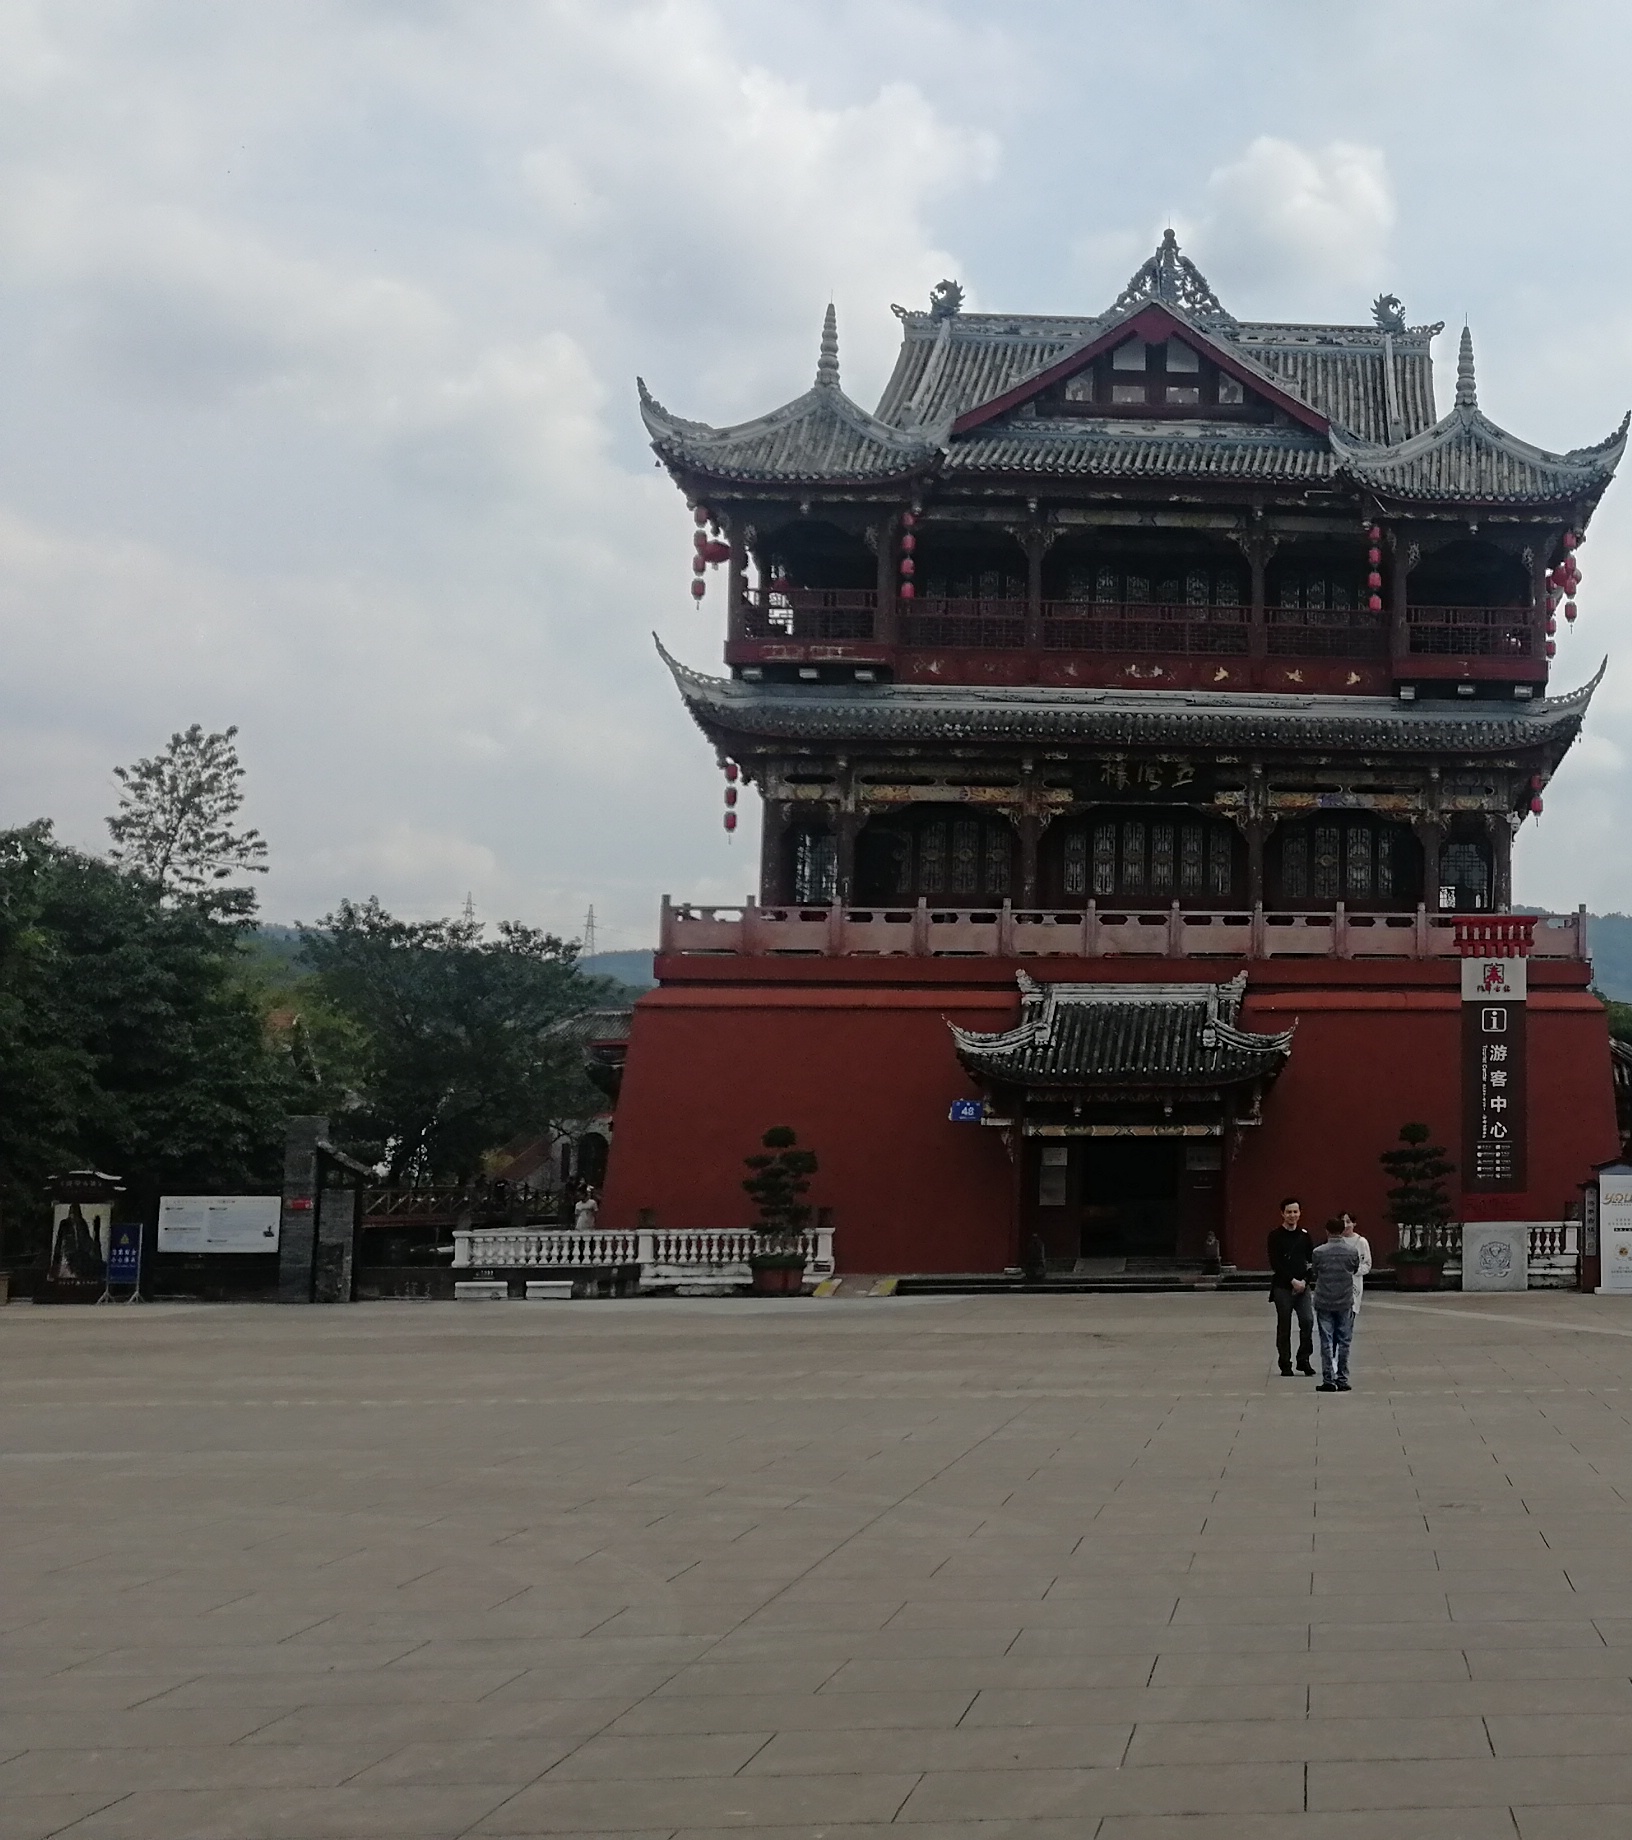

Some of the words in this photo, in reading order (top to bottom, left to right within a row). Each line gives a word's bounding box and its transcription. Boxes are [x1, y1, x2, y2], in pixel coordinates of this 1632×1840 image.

[961, 1106, 975, 1116] 48
[1489, 1044, 1508, 1139] 游客中心
